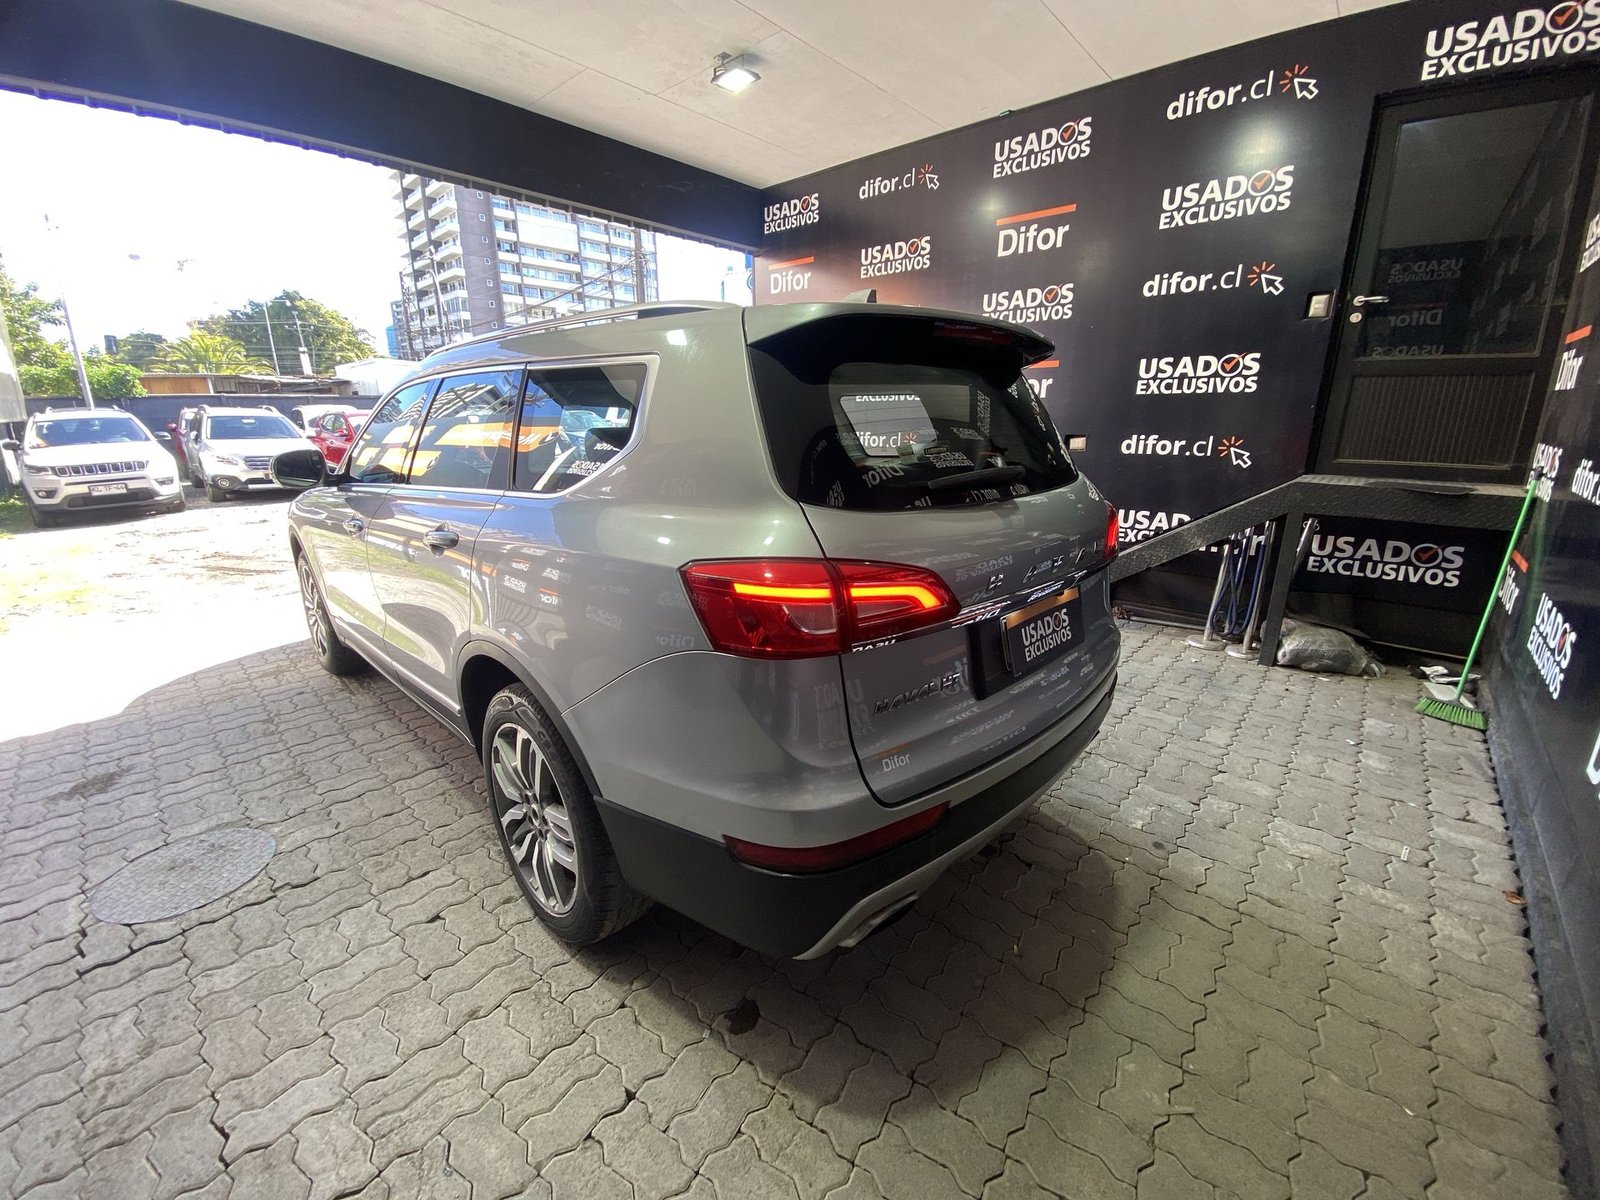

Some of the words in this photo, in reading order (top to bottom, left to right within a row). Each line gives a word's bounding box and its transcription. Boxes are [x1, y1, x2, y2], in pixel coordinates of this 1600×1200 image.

[1425, 0, 1600, 57] USADOS
[1420, 27, 1600, 81] EXCLUSIVOS
[1166, 71, 1274, 120] difor.cl
[994, 117, 1092, 161] USADOS
[992, 140, 1090, 179] EXCLUSIVOS
[859, 168, 915, 200] difor.cl
[1162, 165, 1294, 211] USADOS
[764, 193, 819, 222] USADOS
[764, 209, 819, 235] EXCLUSIVOS
[1158, 190, 1291, 230] EXCLUSIVOS
[860, 236, 931, 265] USADOS
[997, 223, 1070, 258] Difor
[770, 269, 811, 294] Difor
[860, 254, 931, 279] EXCLUSIVOS
[1142, 264, 1242, 298] difor.cl
[982, 304, 1073, 324] CLUSIVOS
[983, 283, 1074, 312] USADOS
[1139, 353, 1261, 379] USADOS
[1555, 348, 1583, 391] Difor
[1136, 376, 1258, 395] EXCLUSIVOS
[857, 431, 901, 448] ifor.cl
[1120, 435, 1213, 457] difor.cl
[1118, 509, 1194, 531] USAD
[1311, 535, 1464, 570] USADOS
[1306, 555, 1460, 588] EXCLUSIVOS
[1021, 607, 1069, 646] USADOS
[1536, 592, 1577, 669] USADOS
[1025, 626, 1072, 662] EXCLUSIVOS
[1527, 625, 1564, 700] EXCLUSIVOS
[881, 752, 911, 773] Difor
